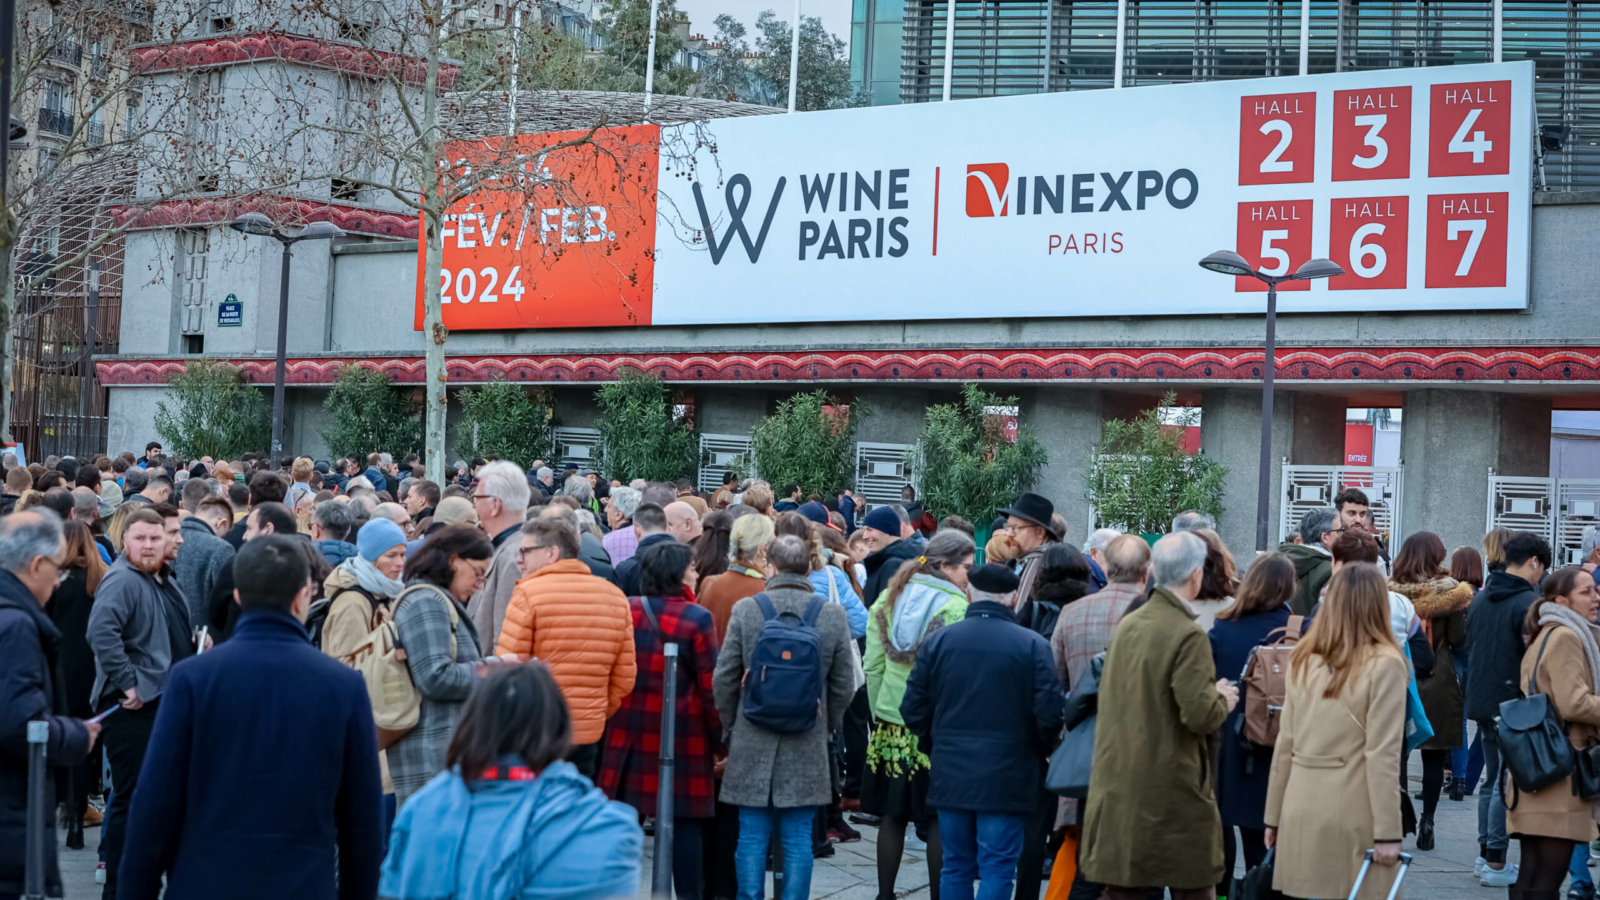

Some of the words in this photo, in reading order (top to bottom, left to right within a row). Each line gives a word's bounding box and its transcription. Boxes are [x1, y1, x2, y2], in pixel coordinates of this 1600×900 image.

[1254, 99, 1304, 116] HALL
[1348, 93, 1399, 110] HALL
[1445, 87, 1498, 105] HALL
[1259, 119, 1294, 173] 2
[1351, 114, 1389, 169] 3
[1448, 108, 1493, 163] 4
[800, 168, 910, 214] WINE
[1345, 202, 1396, 218] HALL
[1442, 198, 1495, 215] HALL
[539, 205, 616, 245] FEB.
[1251, 205, 1300, 221] HALL
[798, 216, 909, 261] PARIS
[1048, 232, 1124, 255] PARIS
[1258, 229, 1291, 276] 5
[1349, 222, 1387, 278] 6
[1447, 219, 1487, 277] 7
[440, 265, 526, 304] 2024
[1348, 453, 1368, 463] ENTRÉE
